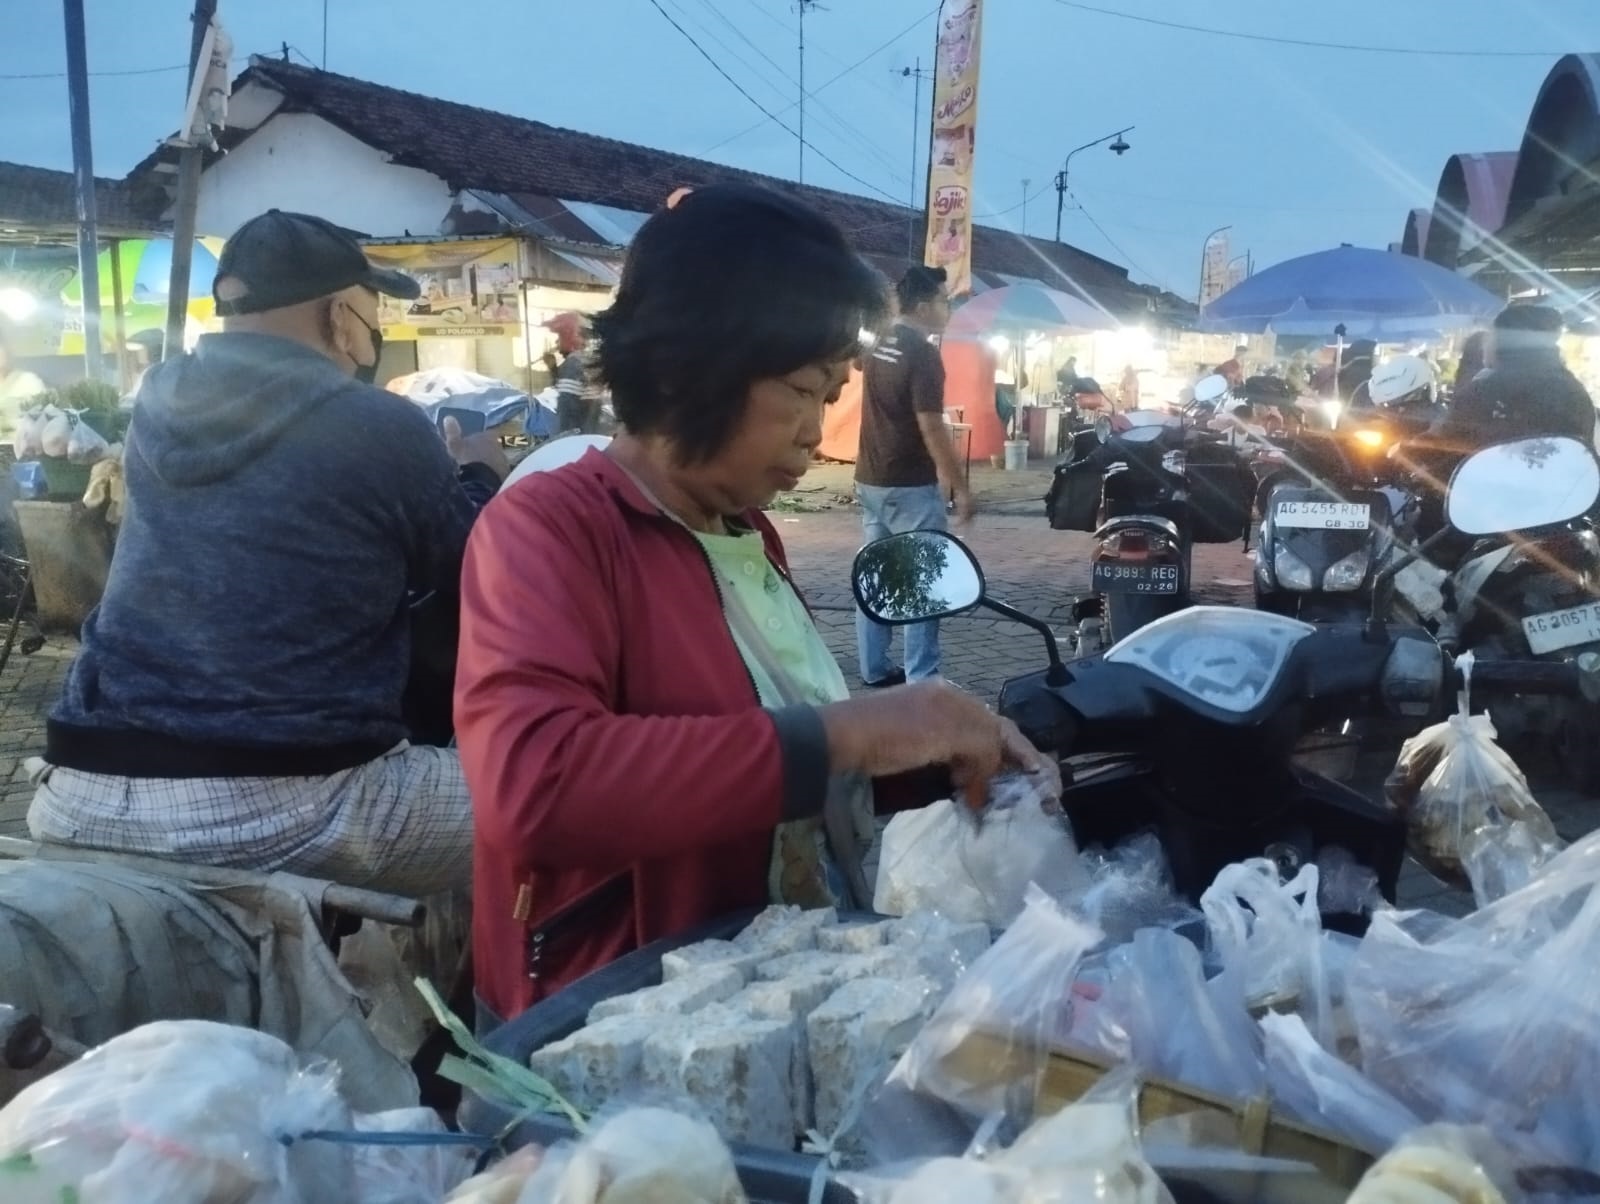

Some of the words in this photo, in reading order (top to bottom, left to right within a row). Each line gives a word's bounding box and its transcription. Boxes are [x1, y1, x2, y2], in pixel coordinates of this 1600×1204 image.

[1280, 503, 1297, 514] AG
[1095, 566, 1112, 578] AG
[1151, 567, 1176, 579] REG
[1527, 618, 1548, 635] AG
